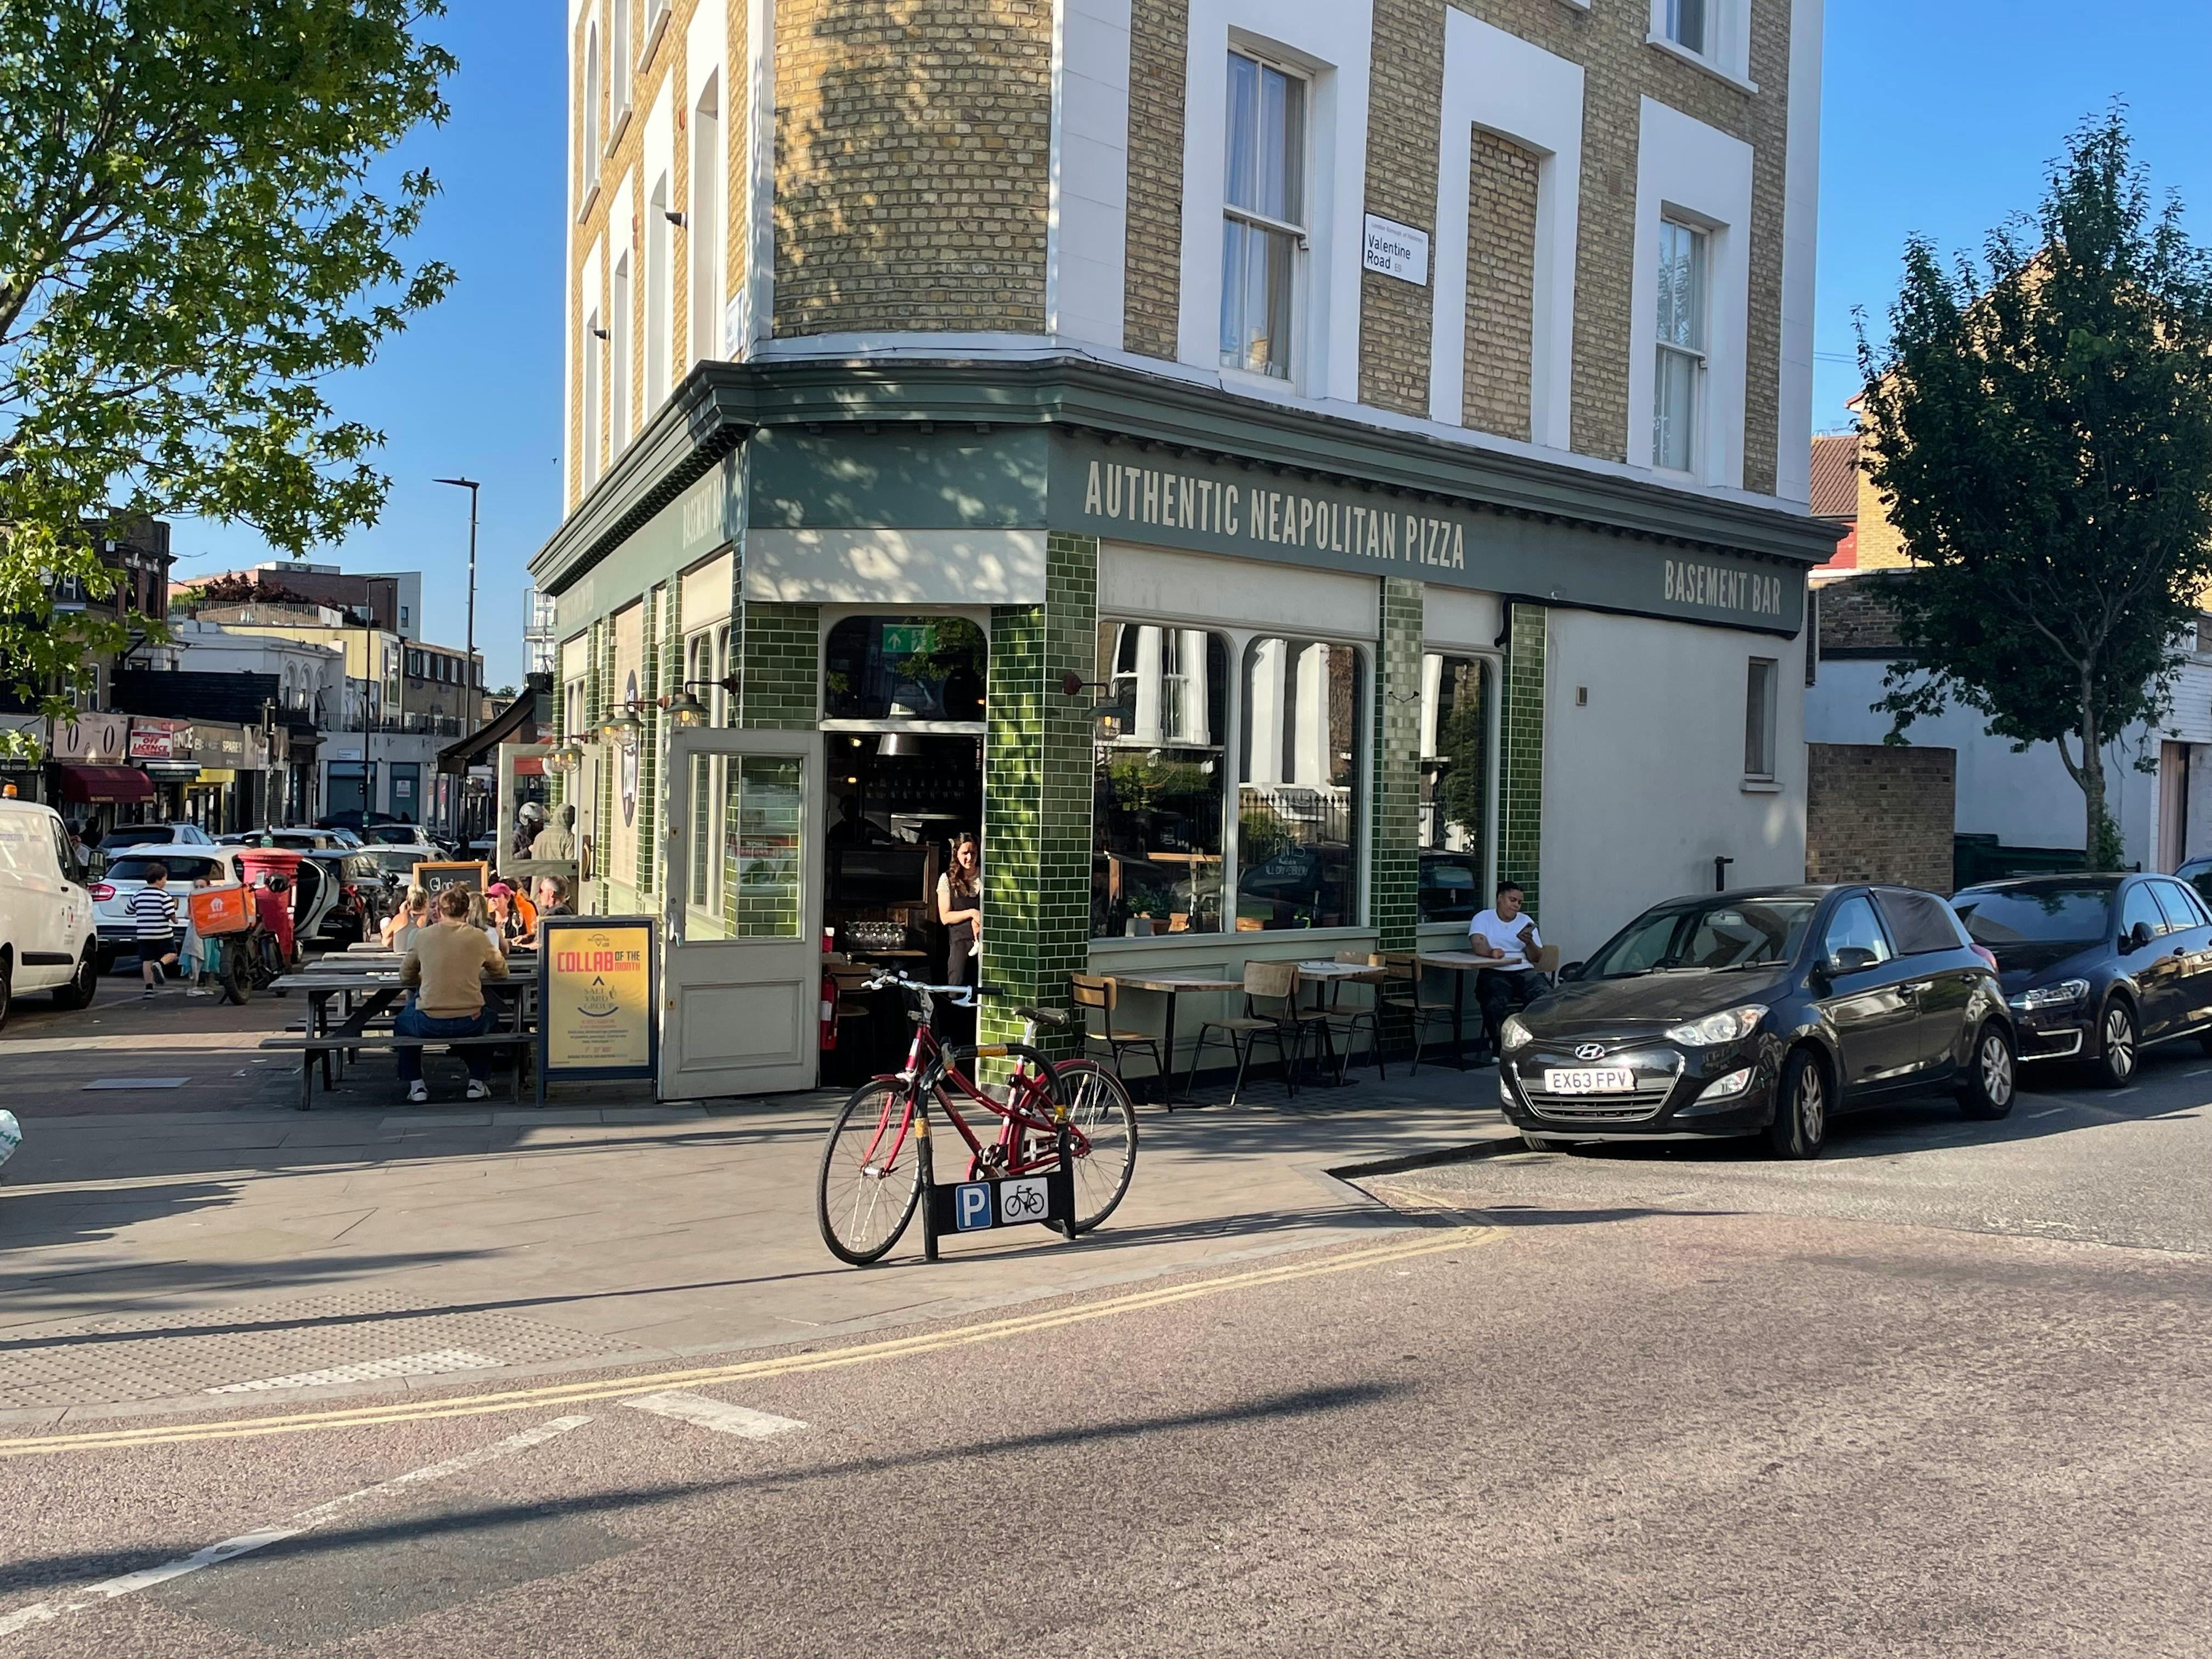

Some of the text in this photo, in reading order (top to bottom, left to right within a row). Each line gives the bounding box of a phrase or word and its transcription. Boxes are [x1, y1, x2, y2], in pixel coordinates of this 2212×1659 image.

[1368, 233, 1410, 260] Valentine
[1367, 250, 1391, 269] Road
[1084, 461, 1464, 569] AUTHENTIC NEAPOLITAN PIZZA
[1664, 560, 1781, 615] BASEMENT BAR
[557, 951, 640, 972] COLLAB OF THE
[614, 962, 640, 972] MONTH
[1553, 1072, 1626, 1088] EX63 FPV
[963, 1188, 986, 1227] P
